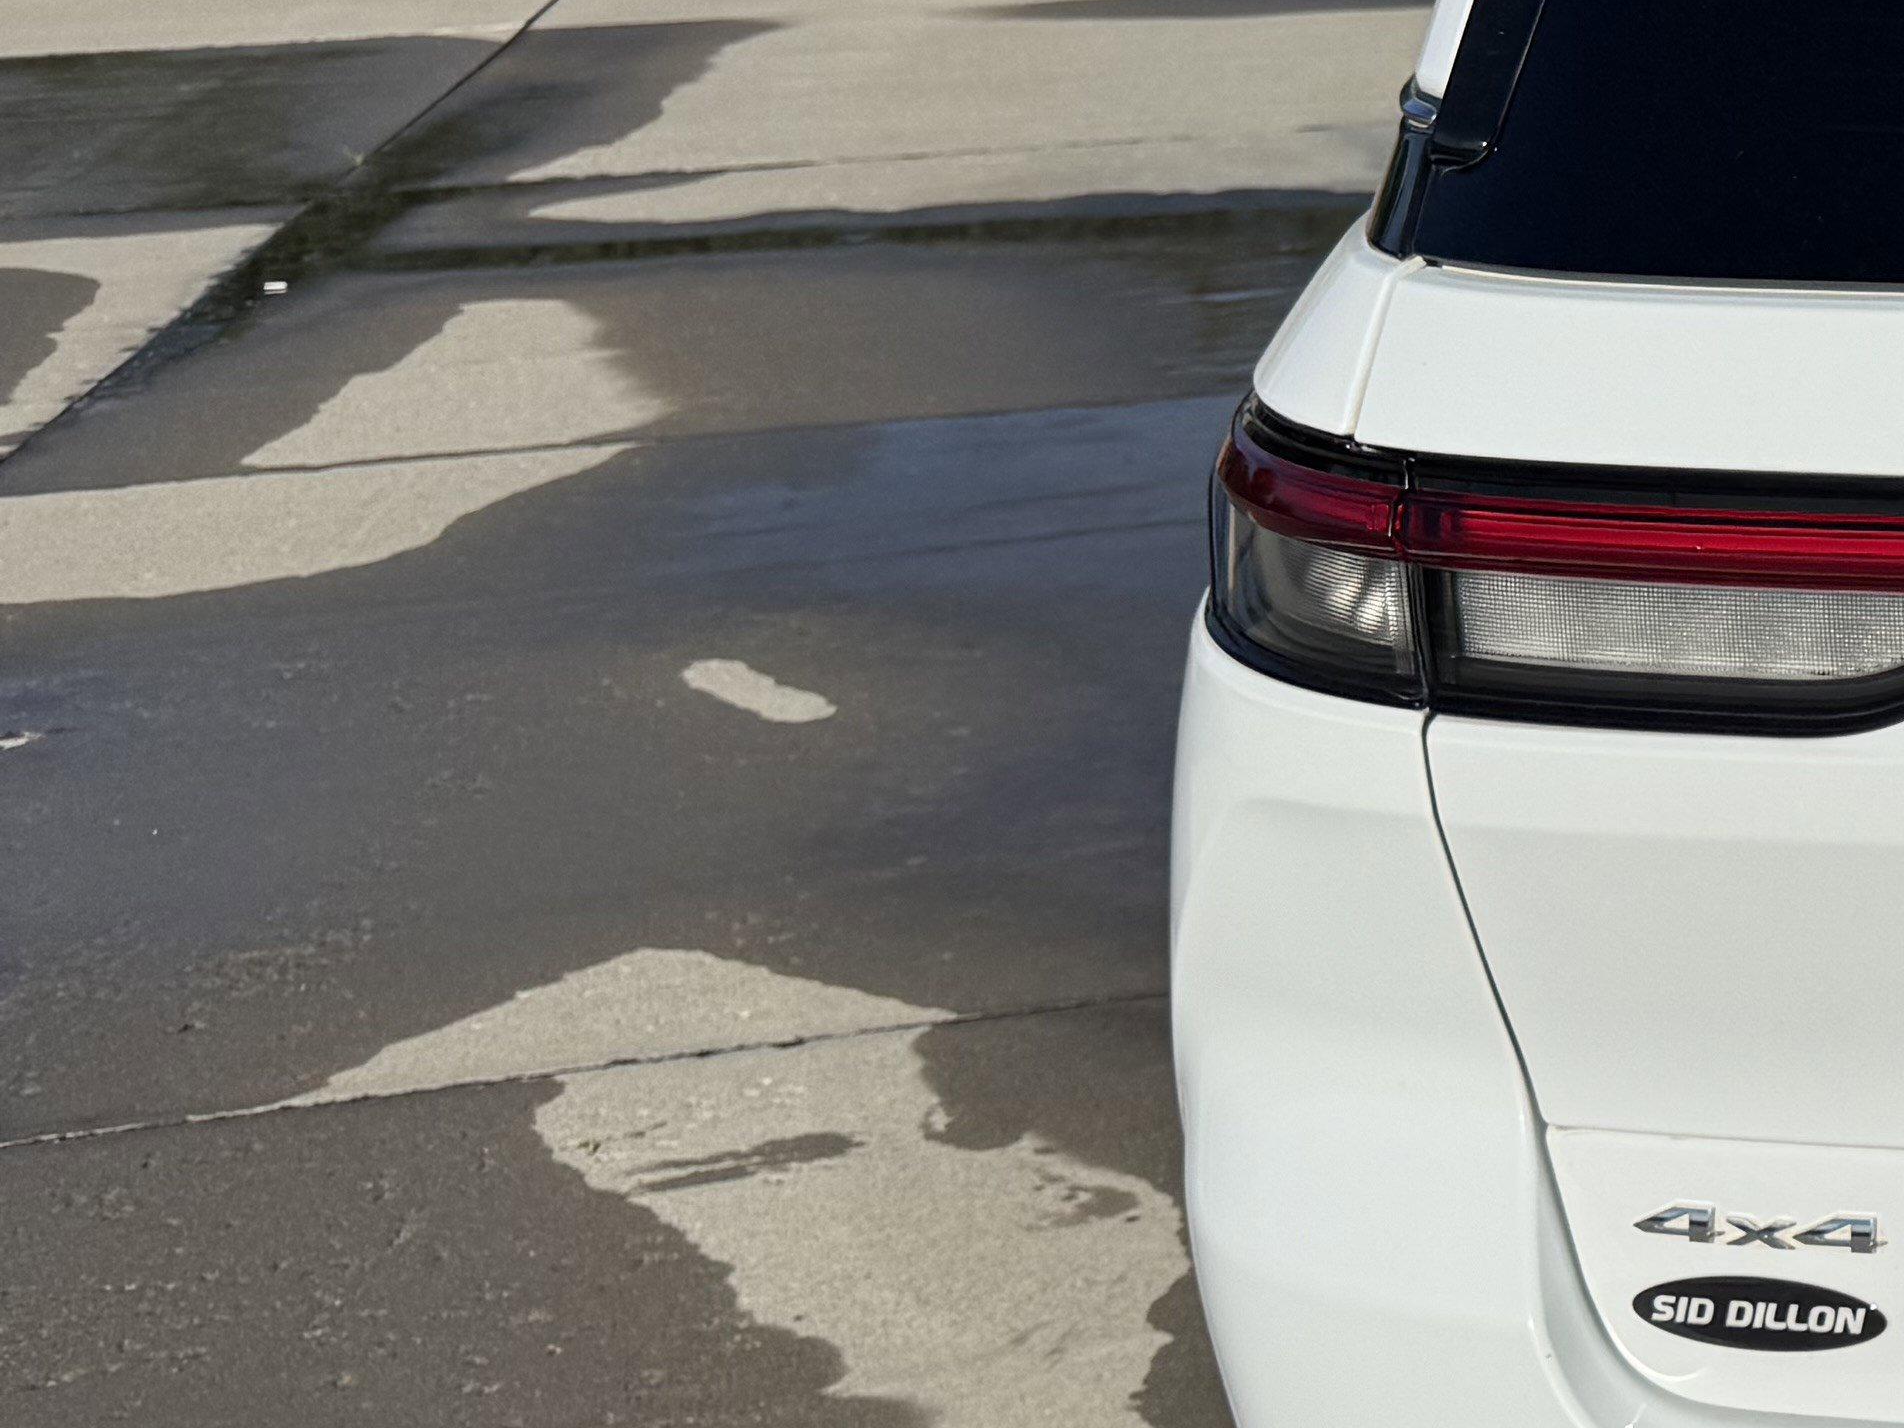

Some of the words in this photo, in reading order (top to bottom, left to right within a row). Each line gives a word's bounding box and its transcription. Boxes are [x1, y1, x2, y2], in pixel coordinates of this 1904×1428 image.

[1632, 1199, 1889, 1255] 4x4
[1651, 1294, 1715, 1326] SID
[1725, 1300, 1867, 1336] DILLON
